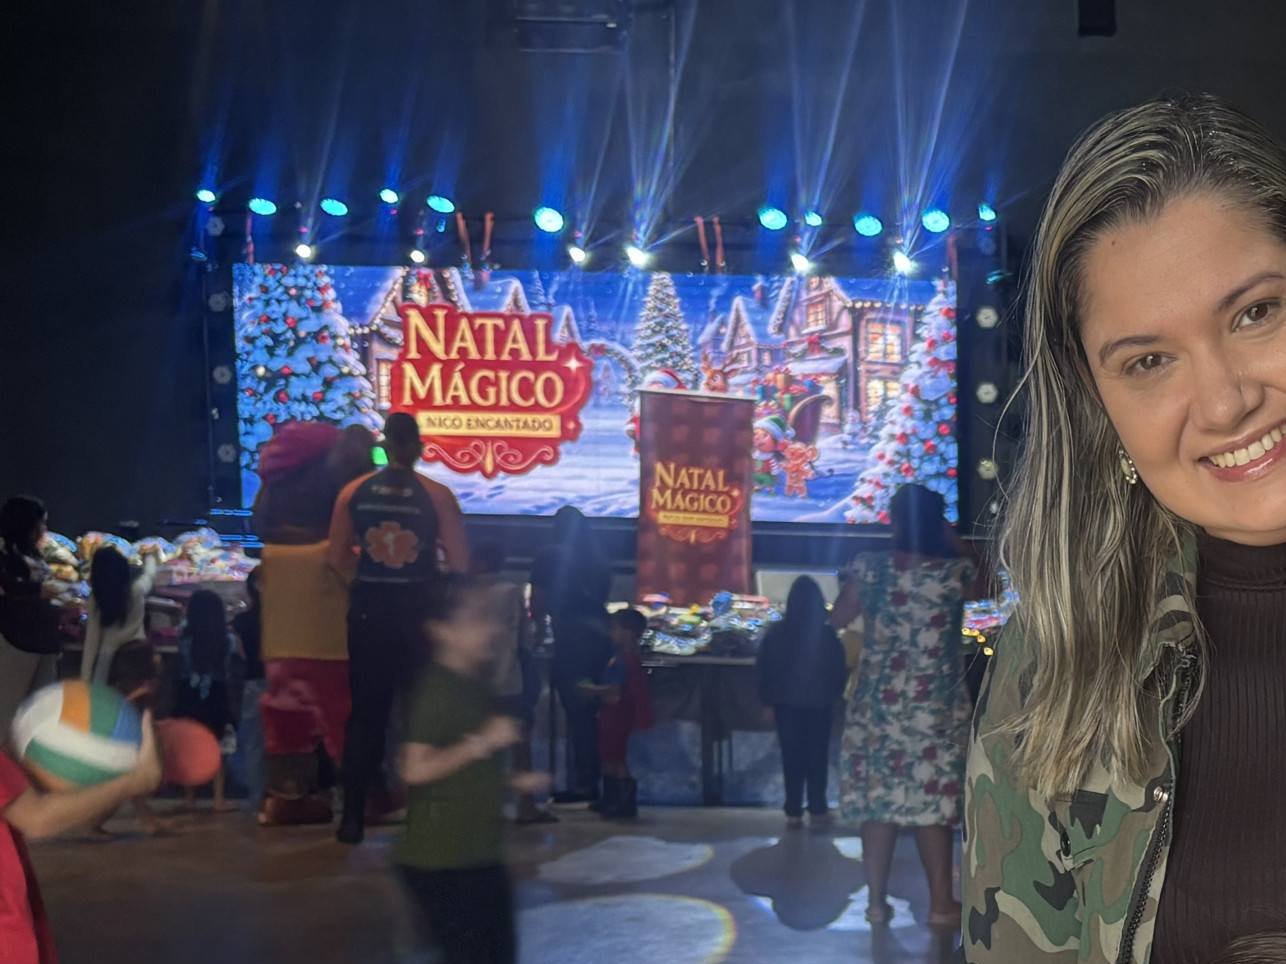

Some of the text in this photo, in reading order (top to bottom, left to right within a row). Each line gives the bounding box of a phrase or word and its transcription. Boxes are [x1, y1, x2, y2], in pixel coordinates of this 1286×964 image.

[405, 308, 559, 361] NATAL
[401, 362, 564, 408] MÁGICO
[466, 417, 553, 431] ENCANTADO
[654, 461, 730, 491] NATAL
[650, 488, 732, 513] MÁGICO
